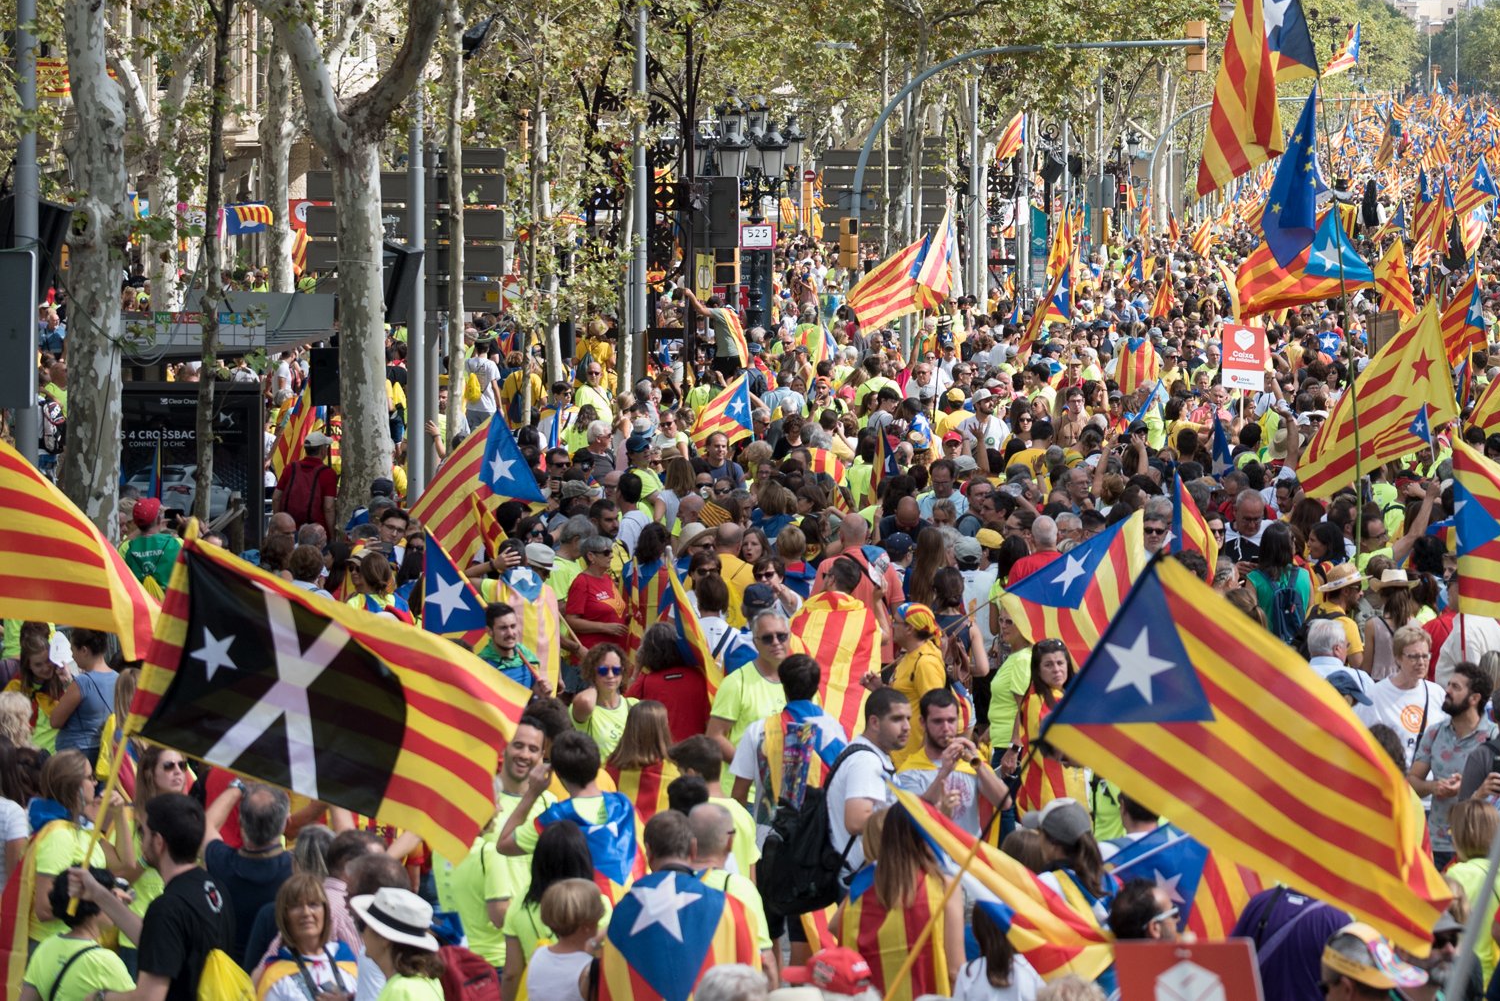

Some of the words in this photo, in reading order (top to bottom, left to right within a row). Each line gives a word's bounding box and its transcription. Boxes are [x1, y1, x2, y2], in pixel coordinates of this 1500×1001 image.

[747, 229, 768, 238] 525
[1232, 350, 1254, 359] Caixa
[128, 430, 136, 439] 4
